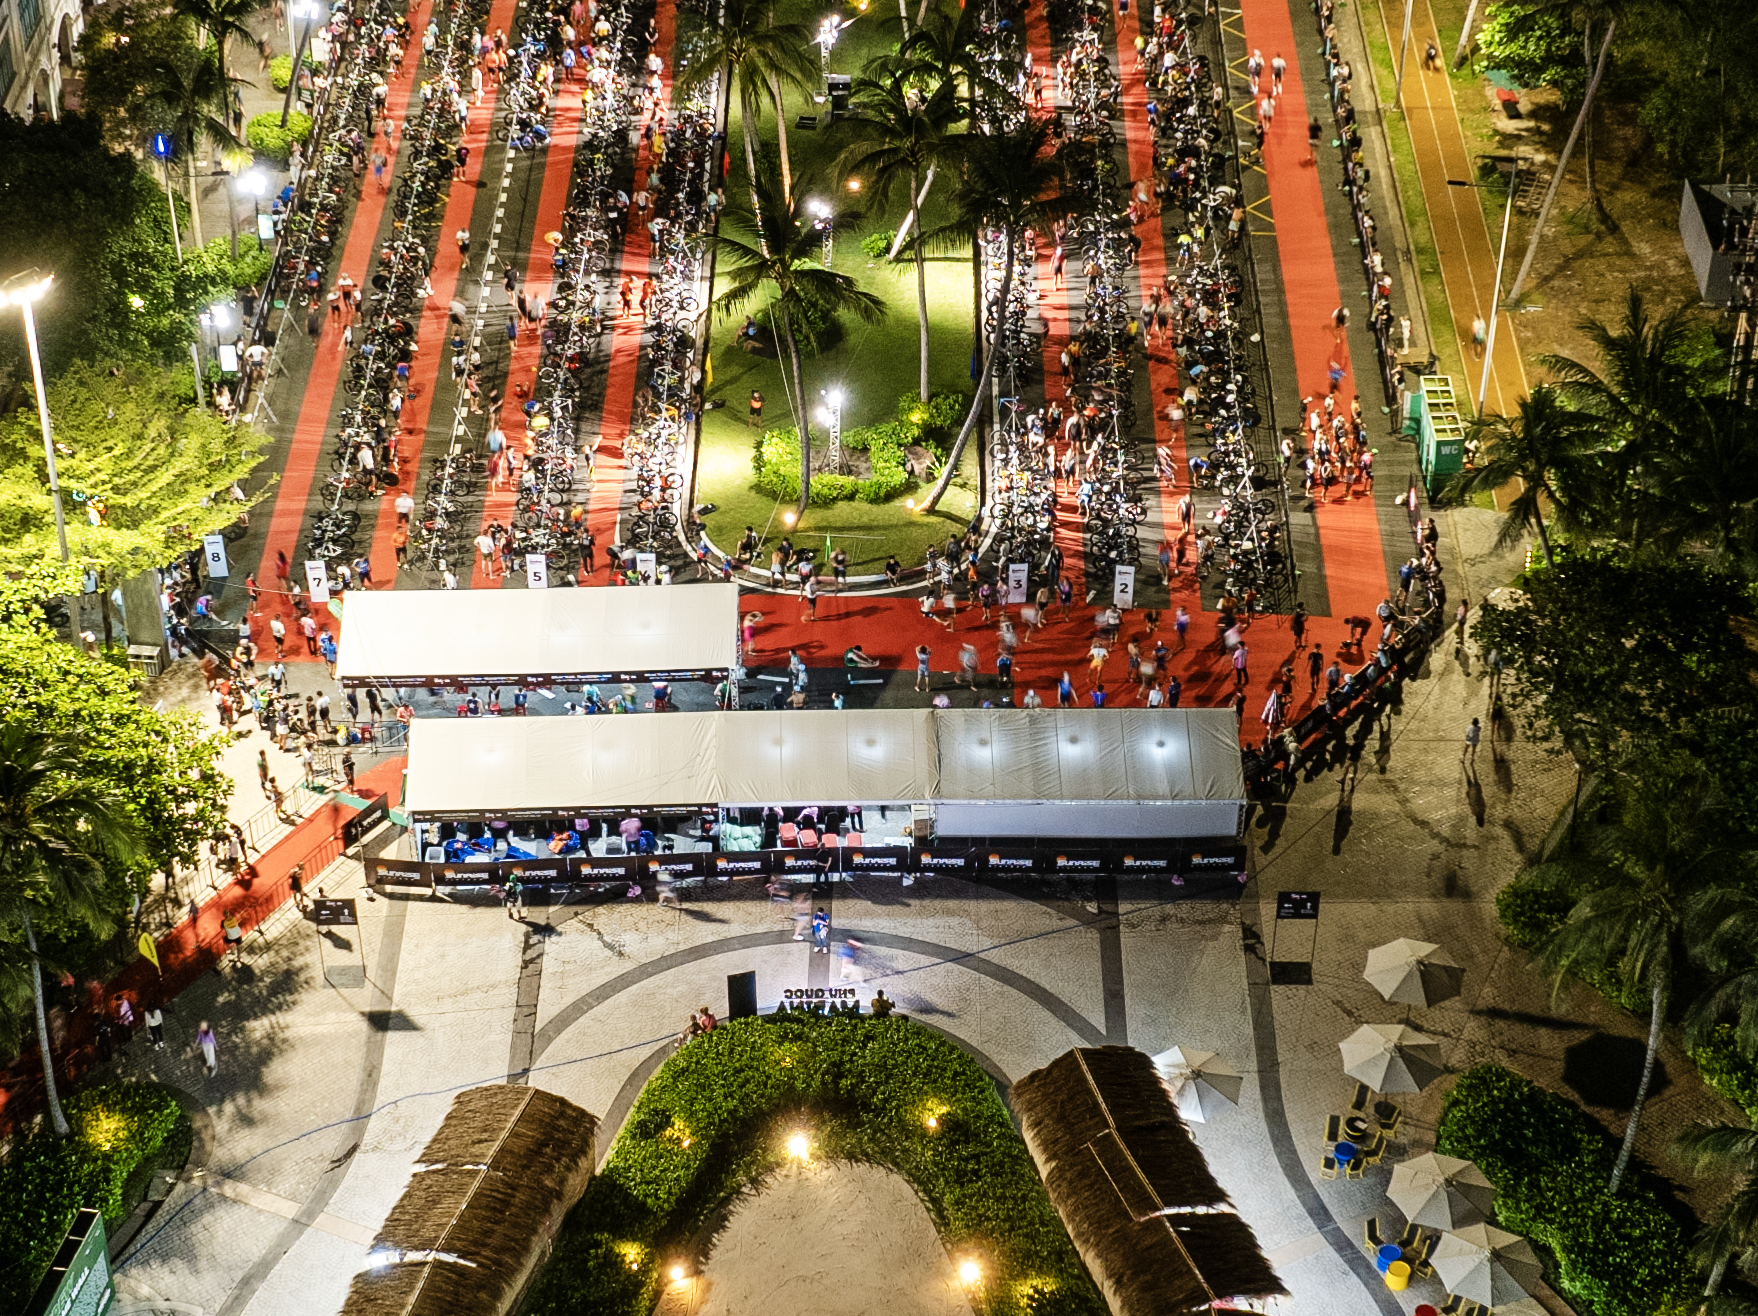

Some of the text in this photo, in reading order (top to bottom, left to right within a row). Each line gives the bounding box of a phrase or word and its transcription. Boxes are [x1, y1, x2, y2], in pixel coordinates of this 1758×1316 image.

[1441, 445, 1459, 455] WC
[211, 552, 221, 563] 8
[533, 571, 542, 582] 5
[312, 577, 322, 588] 7
[1013, 579, 1023, 590] 3
[1119, 583, 1129, 594] 2
